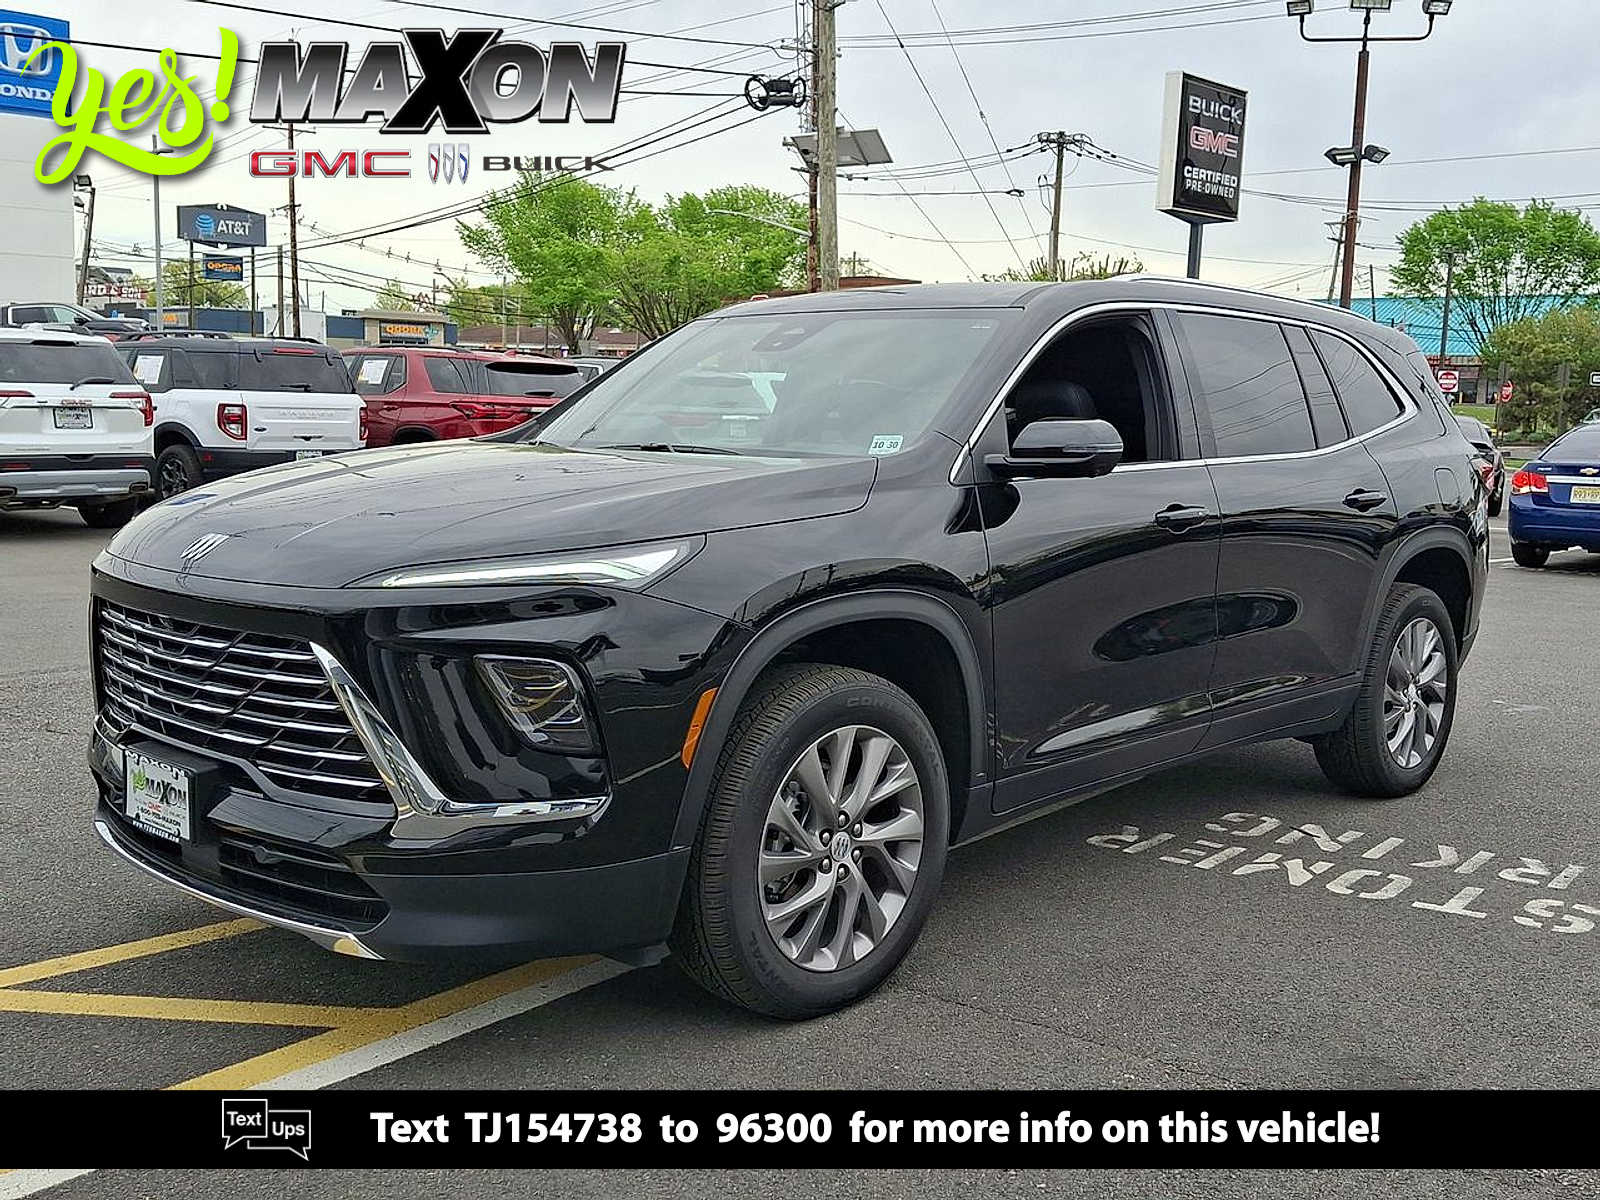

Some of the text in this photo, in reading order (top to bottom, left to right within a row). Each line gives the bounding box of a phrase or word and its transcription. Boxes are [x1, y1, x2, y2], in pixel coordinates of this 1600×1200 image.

[0, 83, 56, 101] OND
[1188, 95, 1243, 125] BUICK
[1190, 126, 1239, 158] GMC
[1184, 165, 1238, 188] CERTIFIED
[1185, 179, 1235, 199] PRE-OWNED
[217, 219, 251, 236] AT&T
[872, 441, 899, 449] 10 30
[125, 749, 185, 781] MAXON
